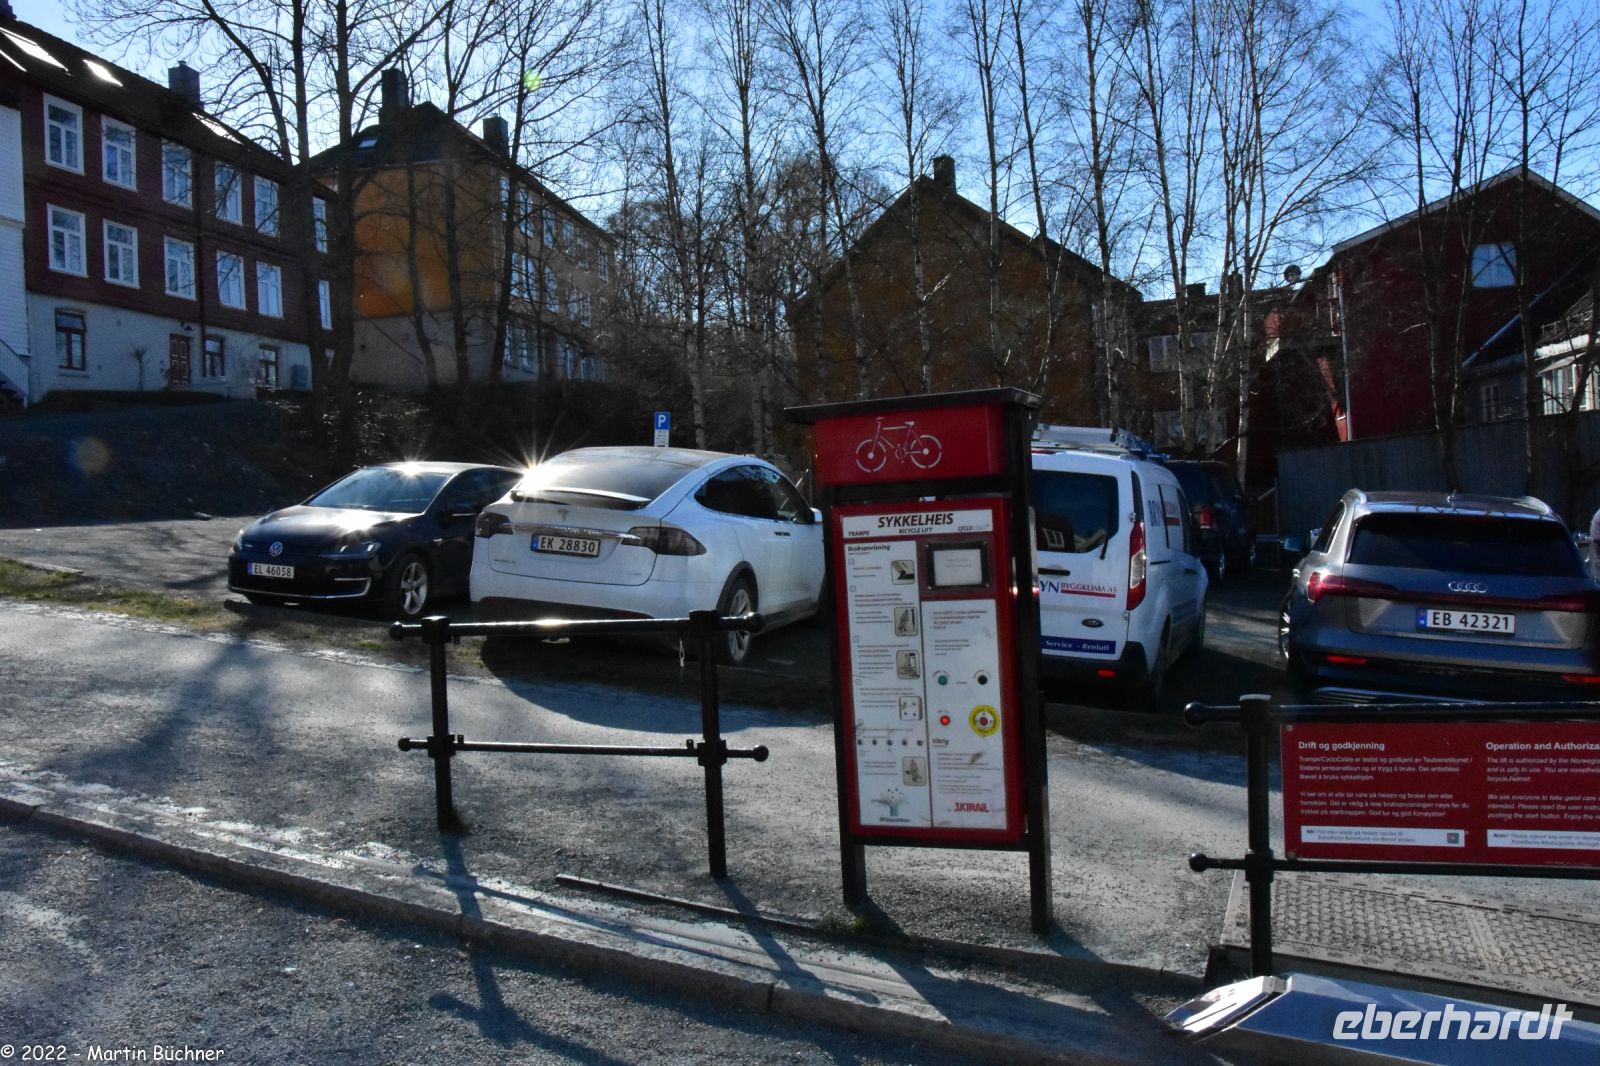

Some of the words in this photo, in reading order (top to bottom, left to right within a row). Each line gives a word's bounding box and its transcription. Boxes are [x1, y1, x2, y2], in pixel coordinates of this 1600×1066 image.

[658, 414, 666, 428] P
[878, 513, 954, 528] SYKKELHEIS
[540, 537, 554, 549] EK
[558, 538, 595, 552] 28830
[254, 564, 263, 574] EL
[266, 566, 292, 576] 46058
[1432, 612, 1452, 626] EB
[1460, 614, 1509, 630] 42321
[1046, 640, 1073, 648] Service
[1298, 742, 1316, 750] Drift
[1318, 744, 1330, 752] og
[1332, 742, 1385, 752] godkjenning
[1486, 742, 1532, 751] Operation
[954, 802, 990, 813] SKIRAIL
